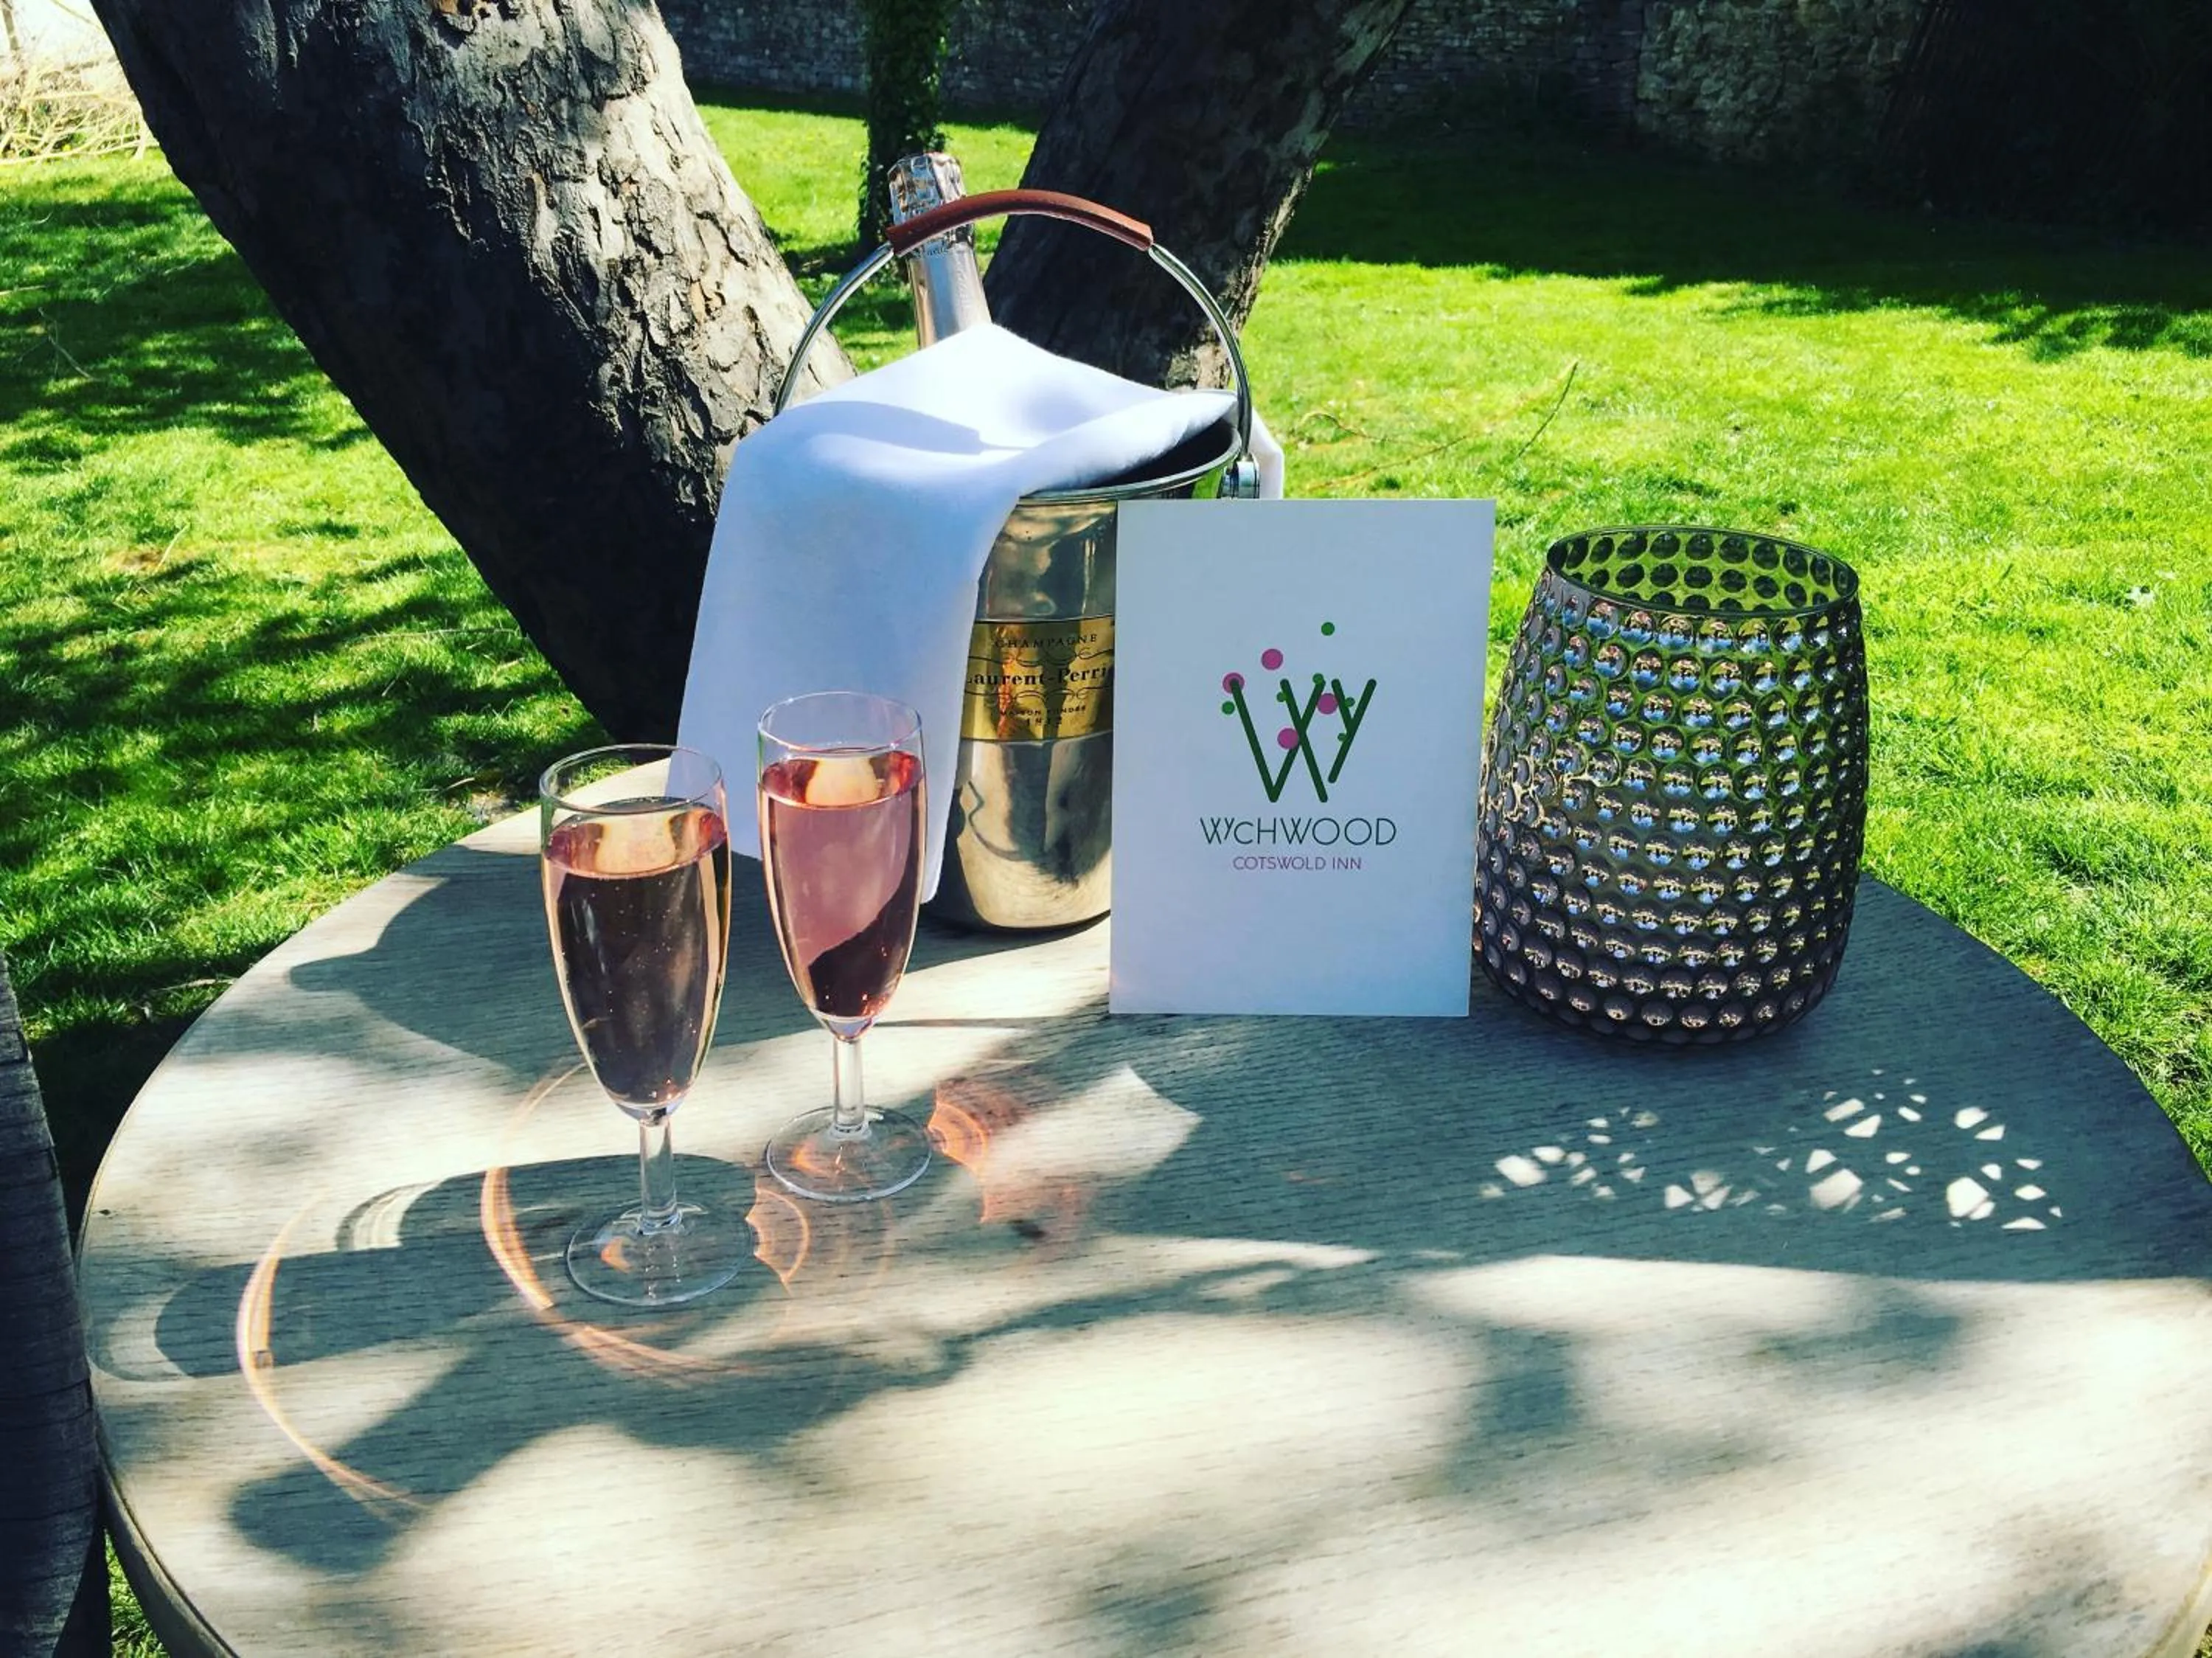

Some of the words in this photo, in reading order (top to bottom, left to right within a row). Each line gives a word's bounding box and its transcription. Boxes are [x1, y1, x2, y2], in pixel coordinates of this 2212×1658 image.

[995, 634, 1097, 648] CHAMPAGNE
[1233, 856, 1326, 870] COTSWOLD
[1332, 856, 1362, 870] INN
